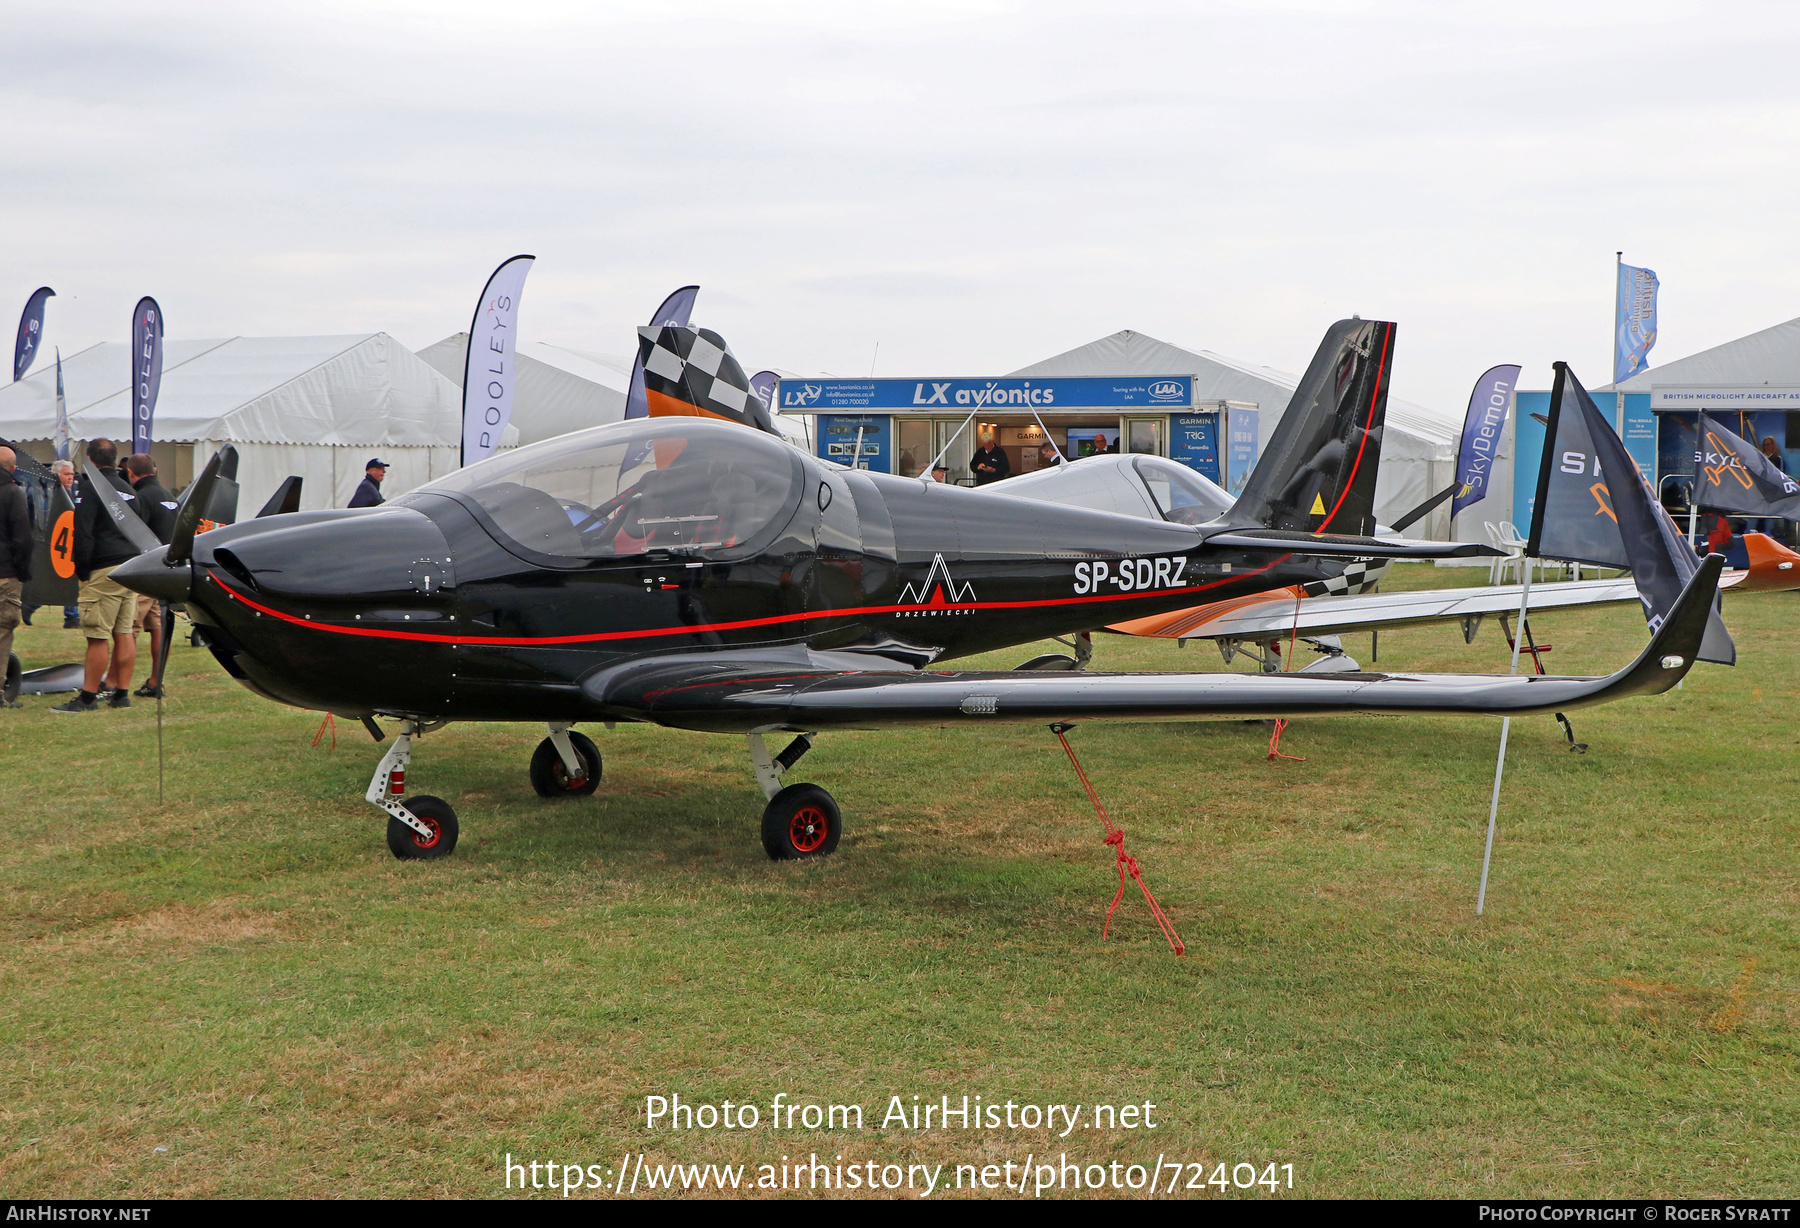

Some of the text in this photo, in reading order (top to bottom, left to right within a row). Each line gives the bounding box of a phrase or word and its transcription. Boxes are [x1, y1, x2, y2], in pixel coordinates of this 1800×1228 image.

[1631, 269, 1644, 334] Microlighting
[1641, 271, 1656, 320] British
[139, 309, 155, 440] POOLEYS
[480, 295, 511, 448] POOLEYS
[1154, 384, 1177, 394] LAA
[784, 392, 808, 405] LX
[913, 382, 1054, 404] LX avionics
[1184, 431, 1206, 440] TRIG
[1466, 381, 1509, 487] SkyDemon
[1073, 556, 1187, 594] SP-SDRZ
[896, 609, 976, 618] DRZEWIECKI
